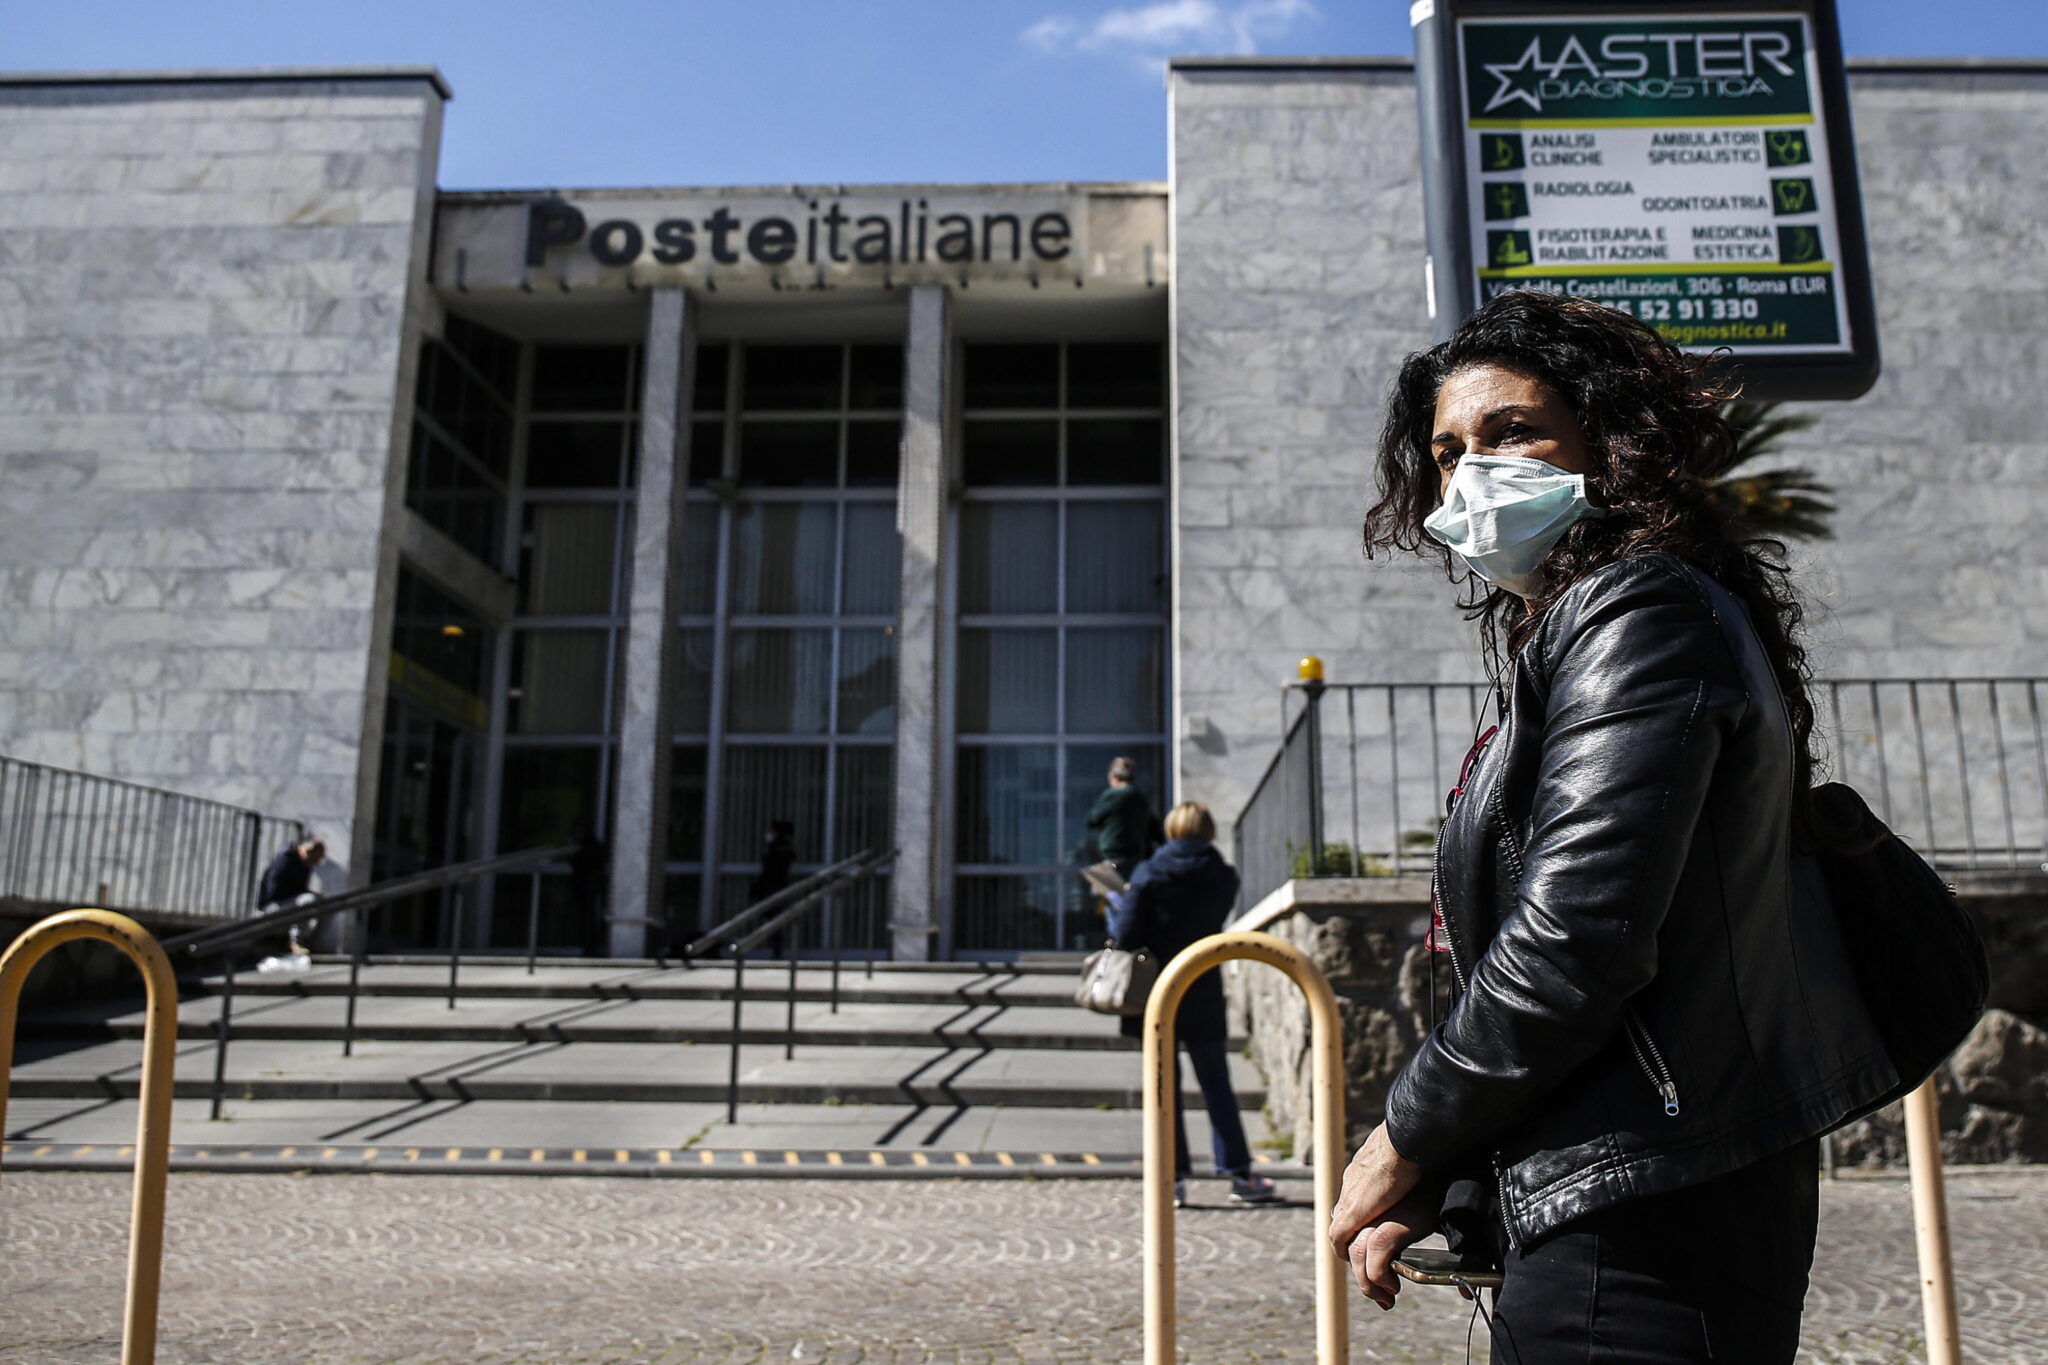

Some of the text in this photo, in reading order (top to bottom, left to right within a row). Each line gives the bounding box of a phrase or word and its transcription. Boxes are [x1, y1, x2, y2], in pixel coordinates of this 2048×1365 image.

[1538, 76, 1775, 99] DIAGNOSTICA
[1530, 134, 1596, 149] ANALISI
[1650, 131, 1760, 147] AMBULATORI
[1530, 151, 1603, 166] CLINICHE
[1648, 148, 1761, 165] SPECIALISTICI
[1533, 181, 1635, 197] RADIOLOGIA
[1642, 195, 1769, 213] ODONTOIATRIA
[1537, 226, 1667, 243] FISIOTERAPIA E
[1691, 225, 1772, 240] MEDICINA
[1538, 244, 1669, 260] RIABILITAZIONE
[1693, 243, 1774, 259] ESTETICA
[1566, 278, 1683, 298] Costellazioni,
[1687, 277, 1723, 296] 306
[1737, 276, 1788, 296] Roma
[1790, 276, 1827, 295] EUR
[1639, 299, 1670, 320] 52
[1677, 299, 1705, 320] 91
[1710, 298, 1759, 320] 330
